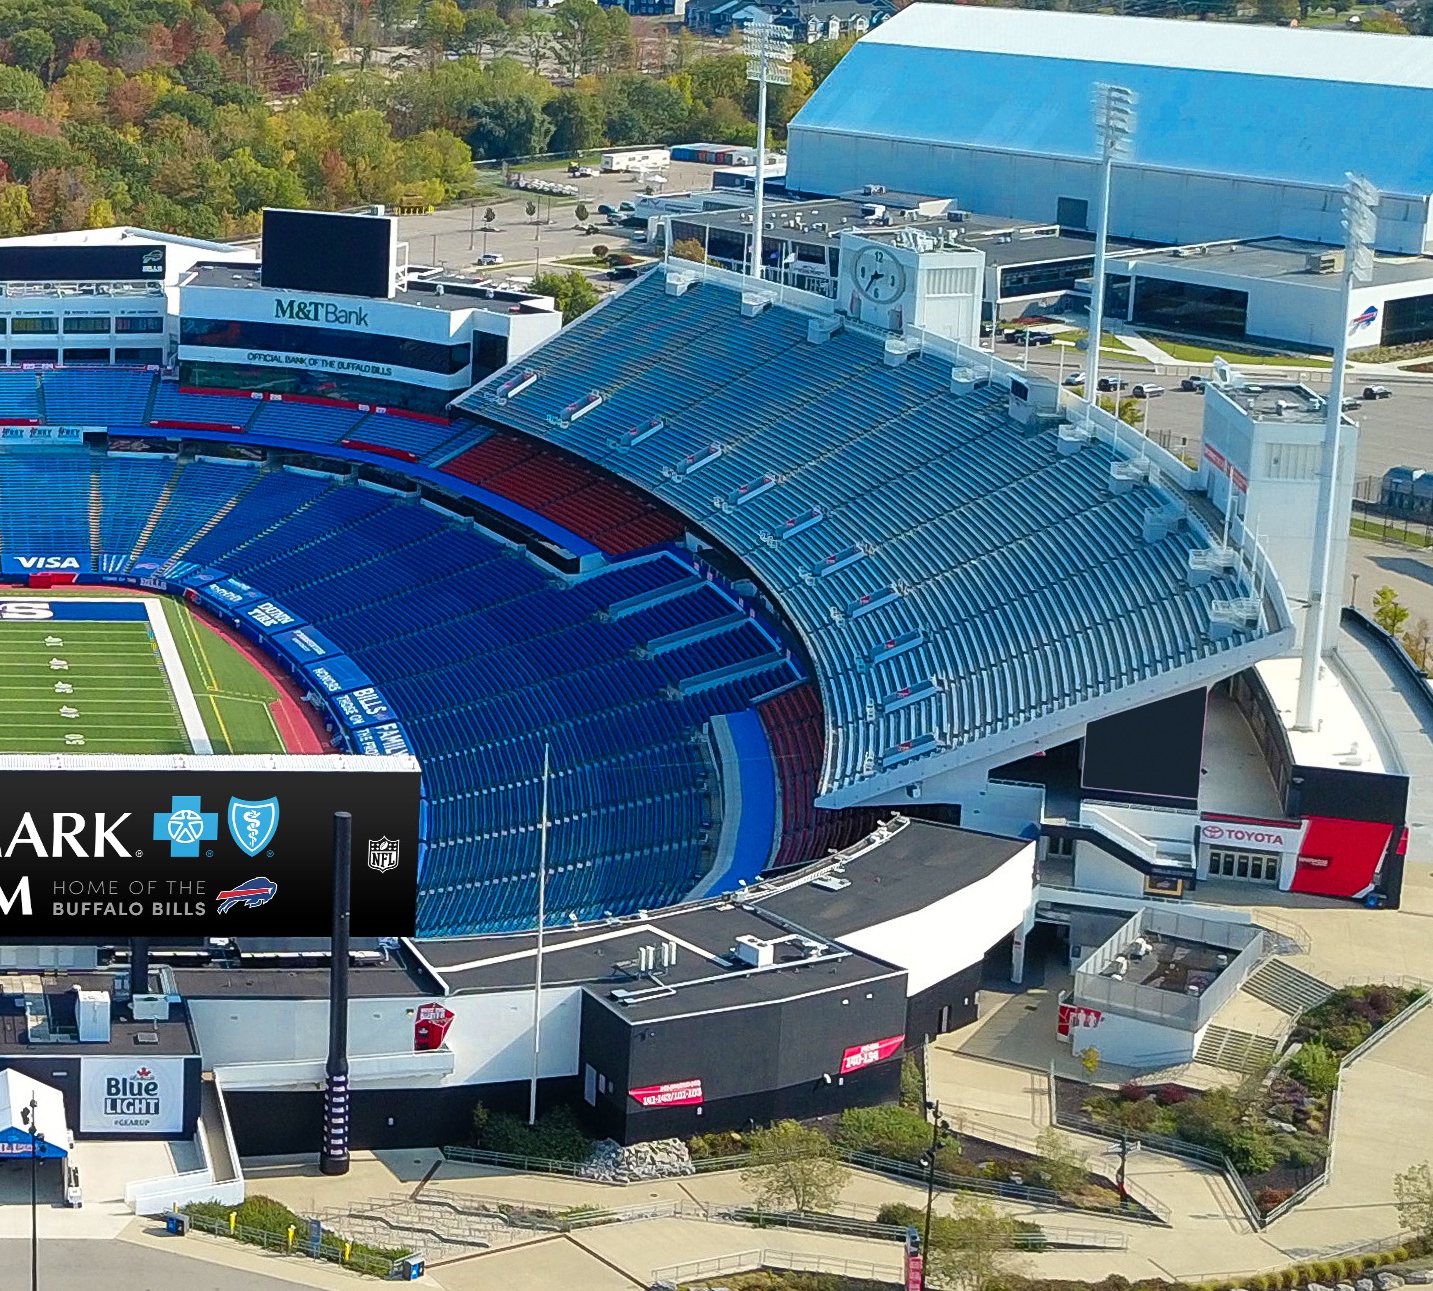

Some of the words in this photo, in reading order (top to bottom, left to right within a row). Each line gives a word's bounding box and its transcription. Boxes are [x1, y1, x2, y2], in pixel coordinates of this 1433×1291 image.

[875, 251, 883, 263] 12
[274, 298, 324, 321] M&T
[325, 303, 369, 327] Bank
[247, 352, 283, 363] OFFICIAL
[308, 357, 319, 367] OF
[321, 359, 336, 368] THE
[13, 556, 80, 569] VISA
[352, 687, 386, 715] BILLS
[1227, 829, 1284, 846] TOYOTA
[53, 880, 119, 895] HOME
[129, 880, 158, 895] OF
[166, 880, 206, 895] THE
[52, 901, 143, 916] BUFFALO
[153, 901, 206, 916] BILLS
[106, 1077, 158, 1096] Blue
[106, 1098, 158, 1114] LIGHT
